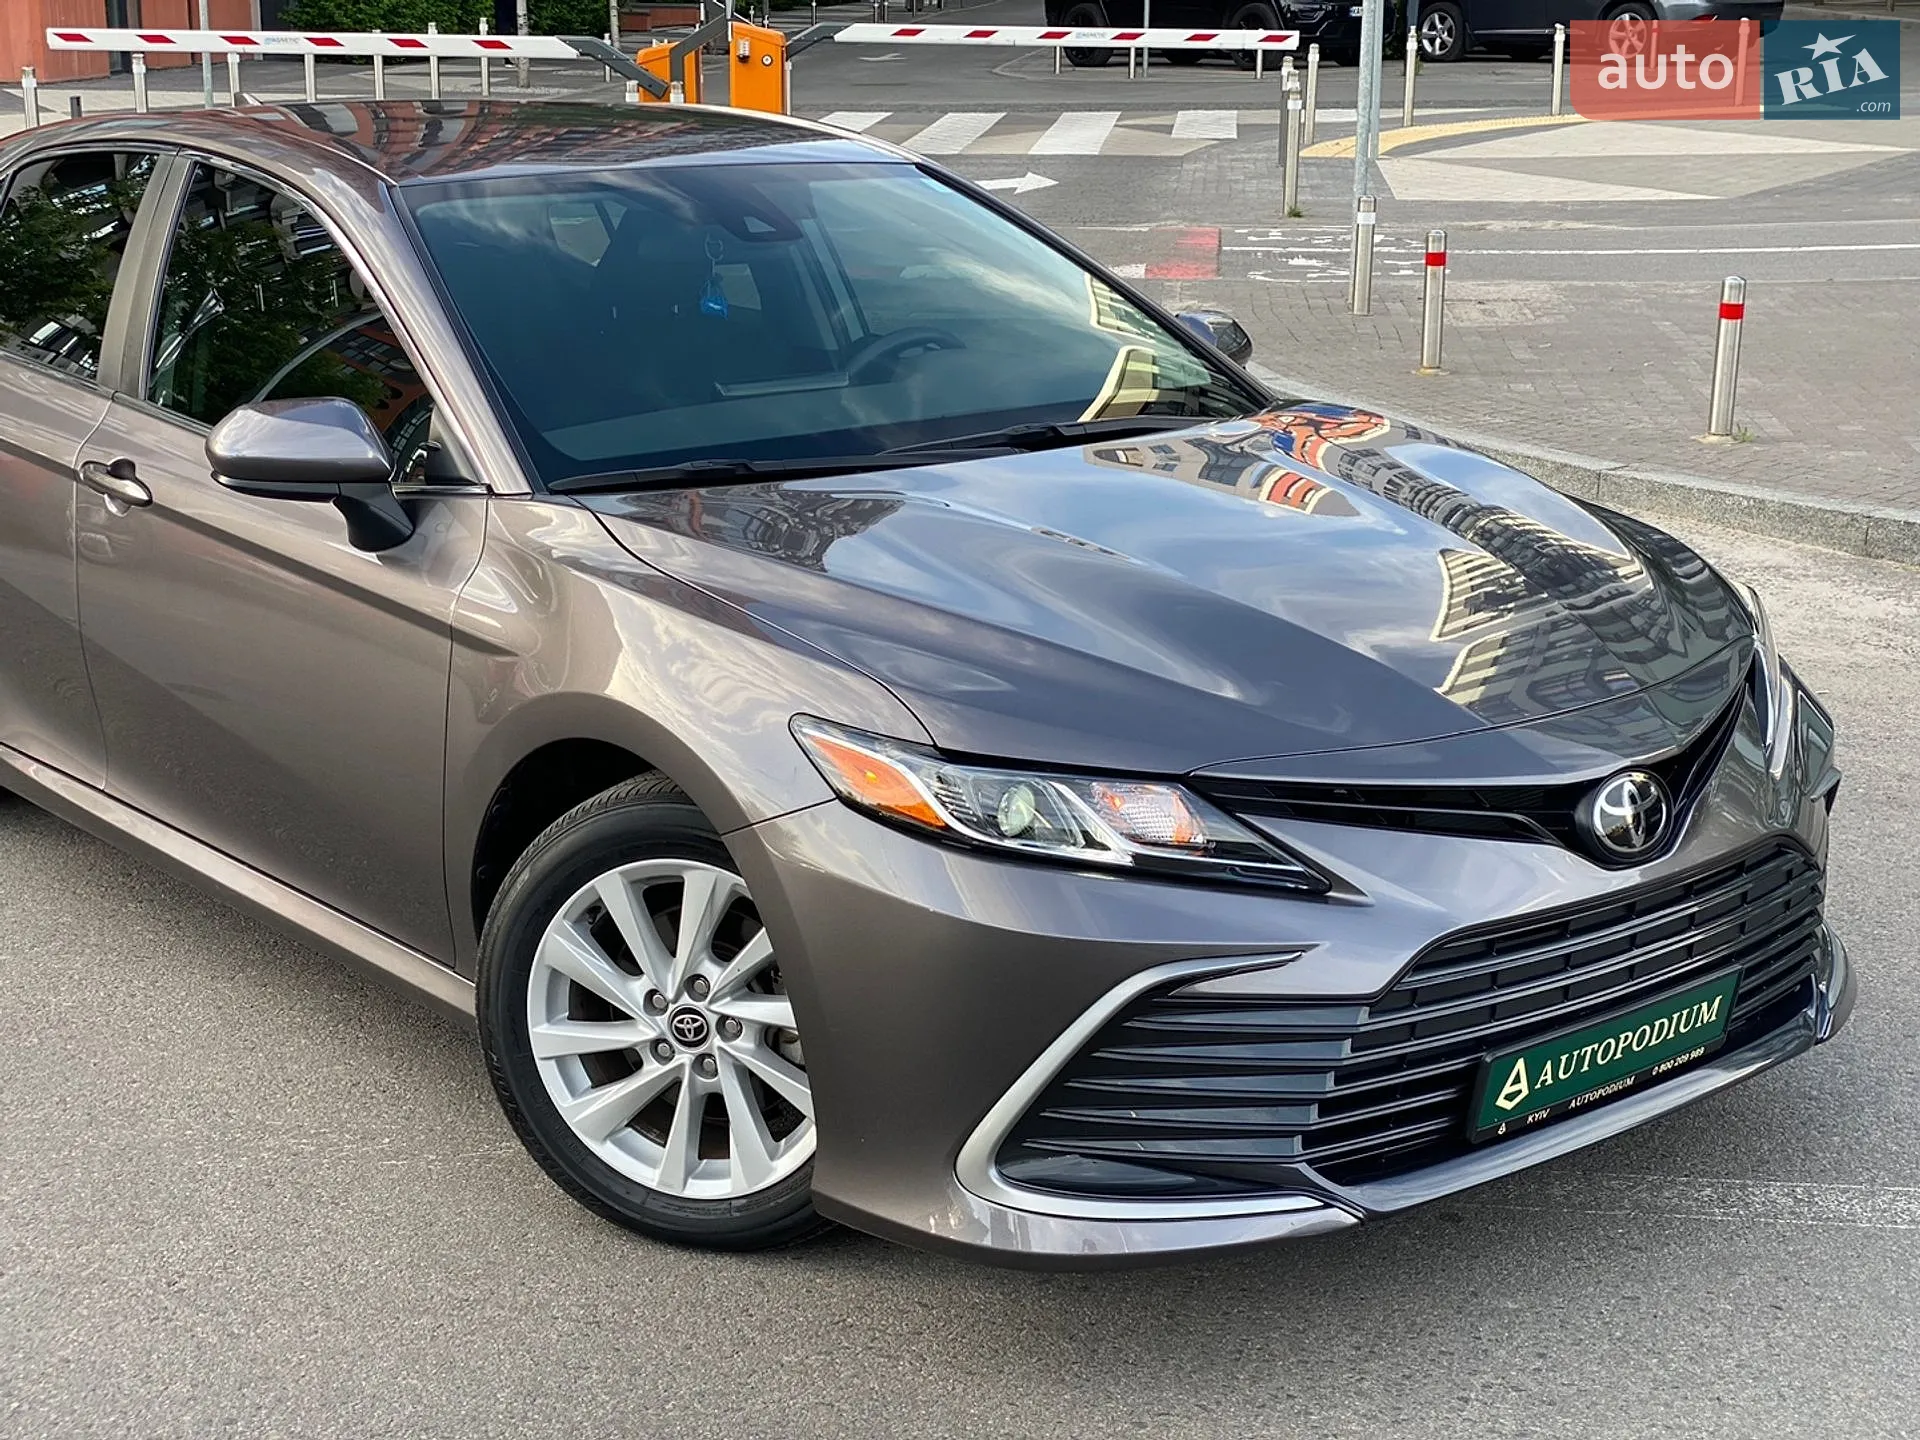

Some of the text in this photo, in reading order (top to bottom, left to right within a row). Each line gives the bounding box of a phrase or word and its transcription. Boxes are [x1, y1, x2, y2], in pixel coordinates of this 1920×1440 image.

[1534, 995, 1723, 1089] AUTOPODIUM
[1526, 1108, 1550, 1124] KYIV
[1568, 1075, 1635, 1110] AUTOPODIUM
